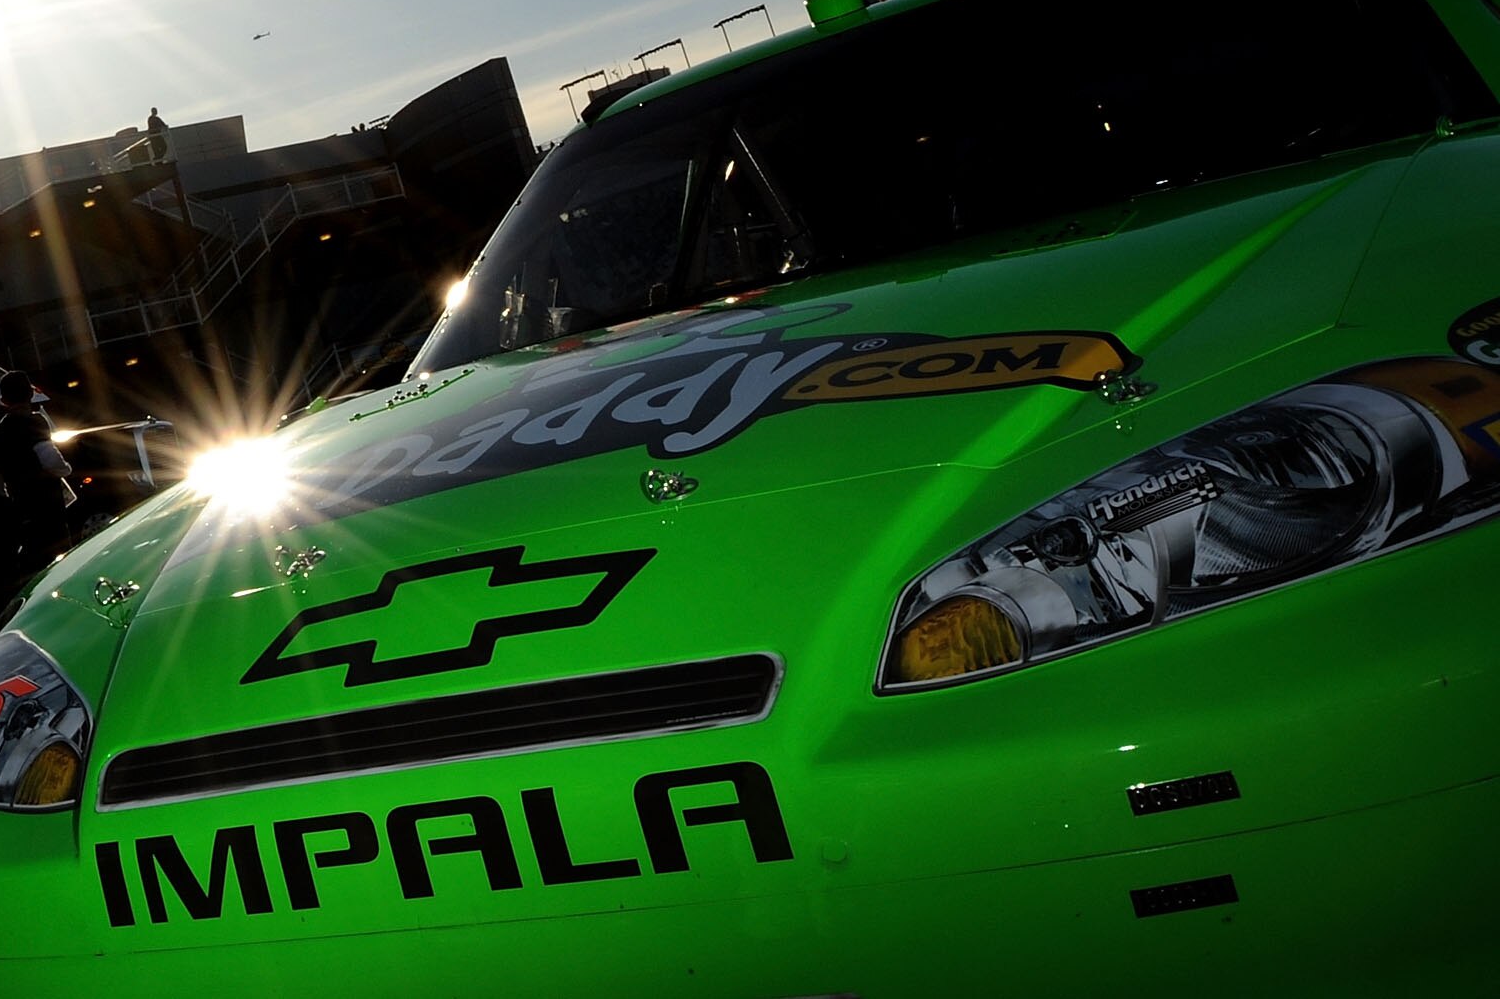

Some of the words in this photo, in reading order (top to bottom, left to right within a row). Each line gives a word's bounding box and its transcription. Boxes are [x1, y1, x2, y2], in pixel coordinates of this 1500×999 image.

[804, 342, 1070, 395] .COM
[1087, 460, 1207, 521] Hendrick
[94, 760, 795, 929] IMPALA
